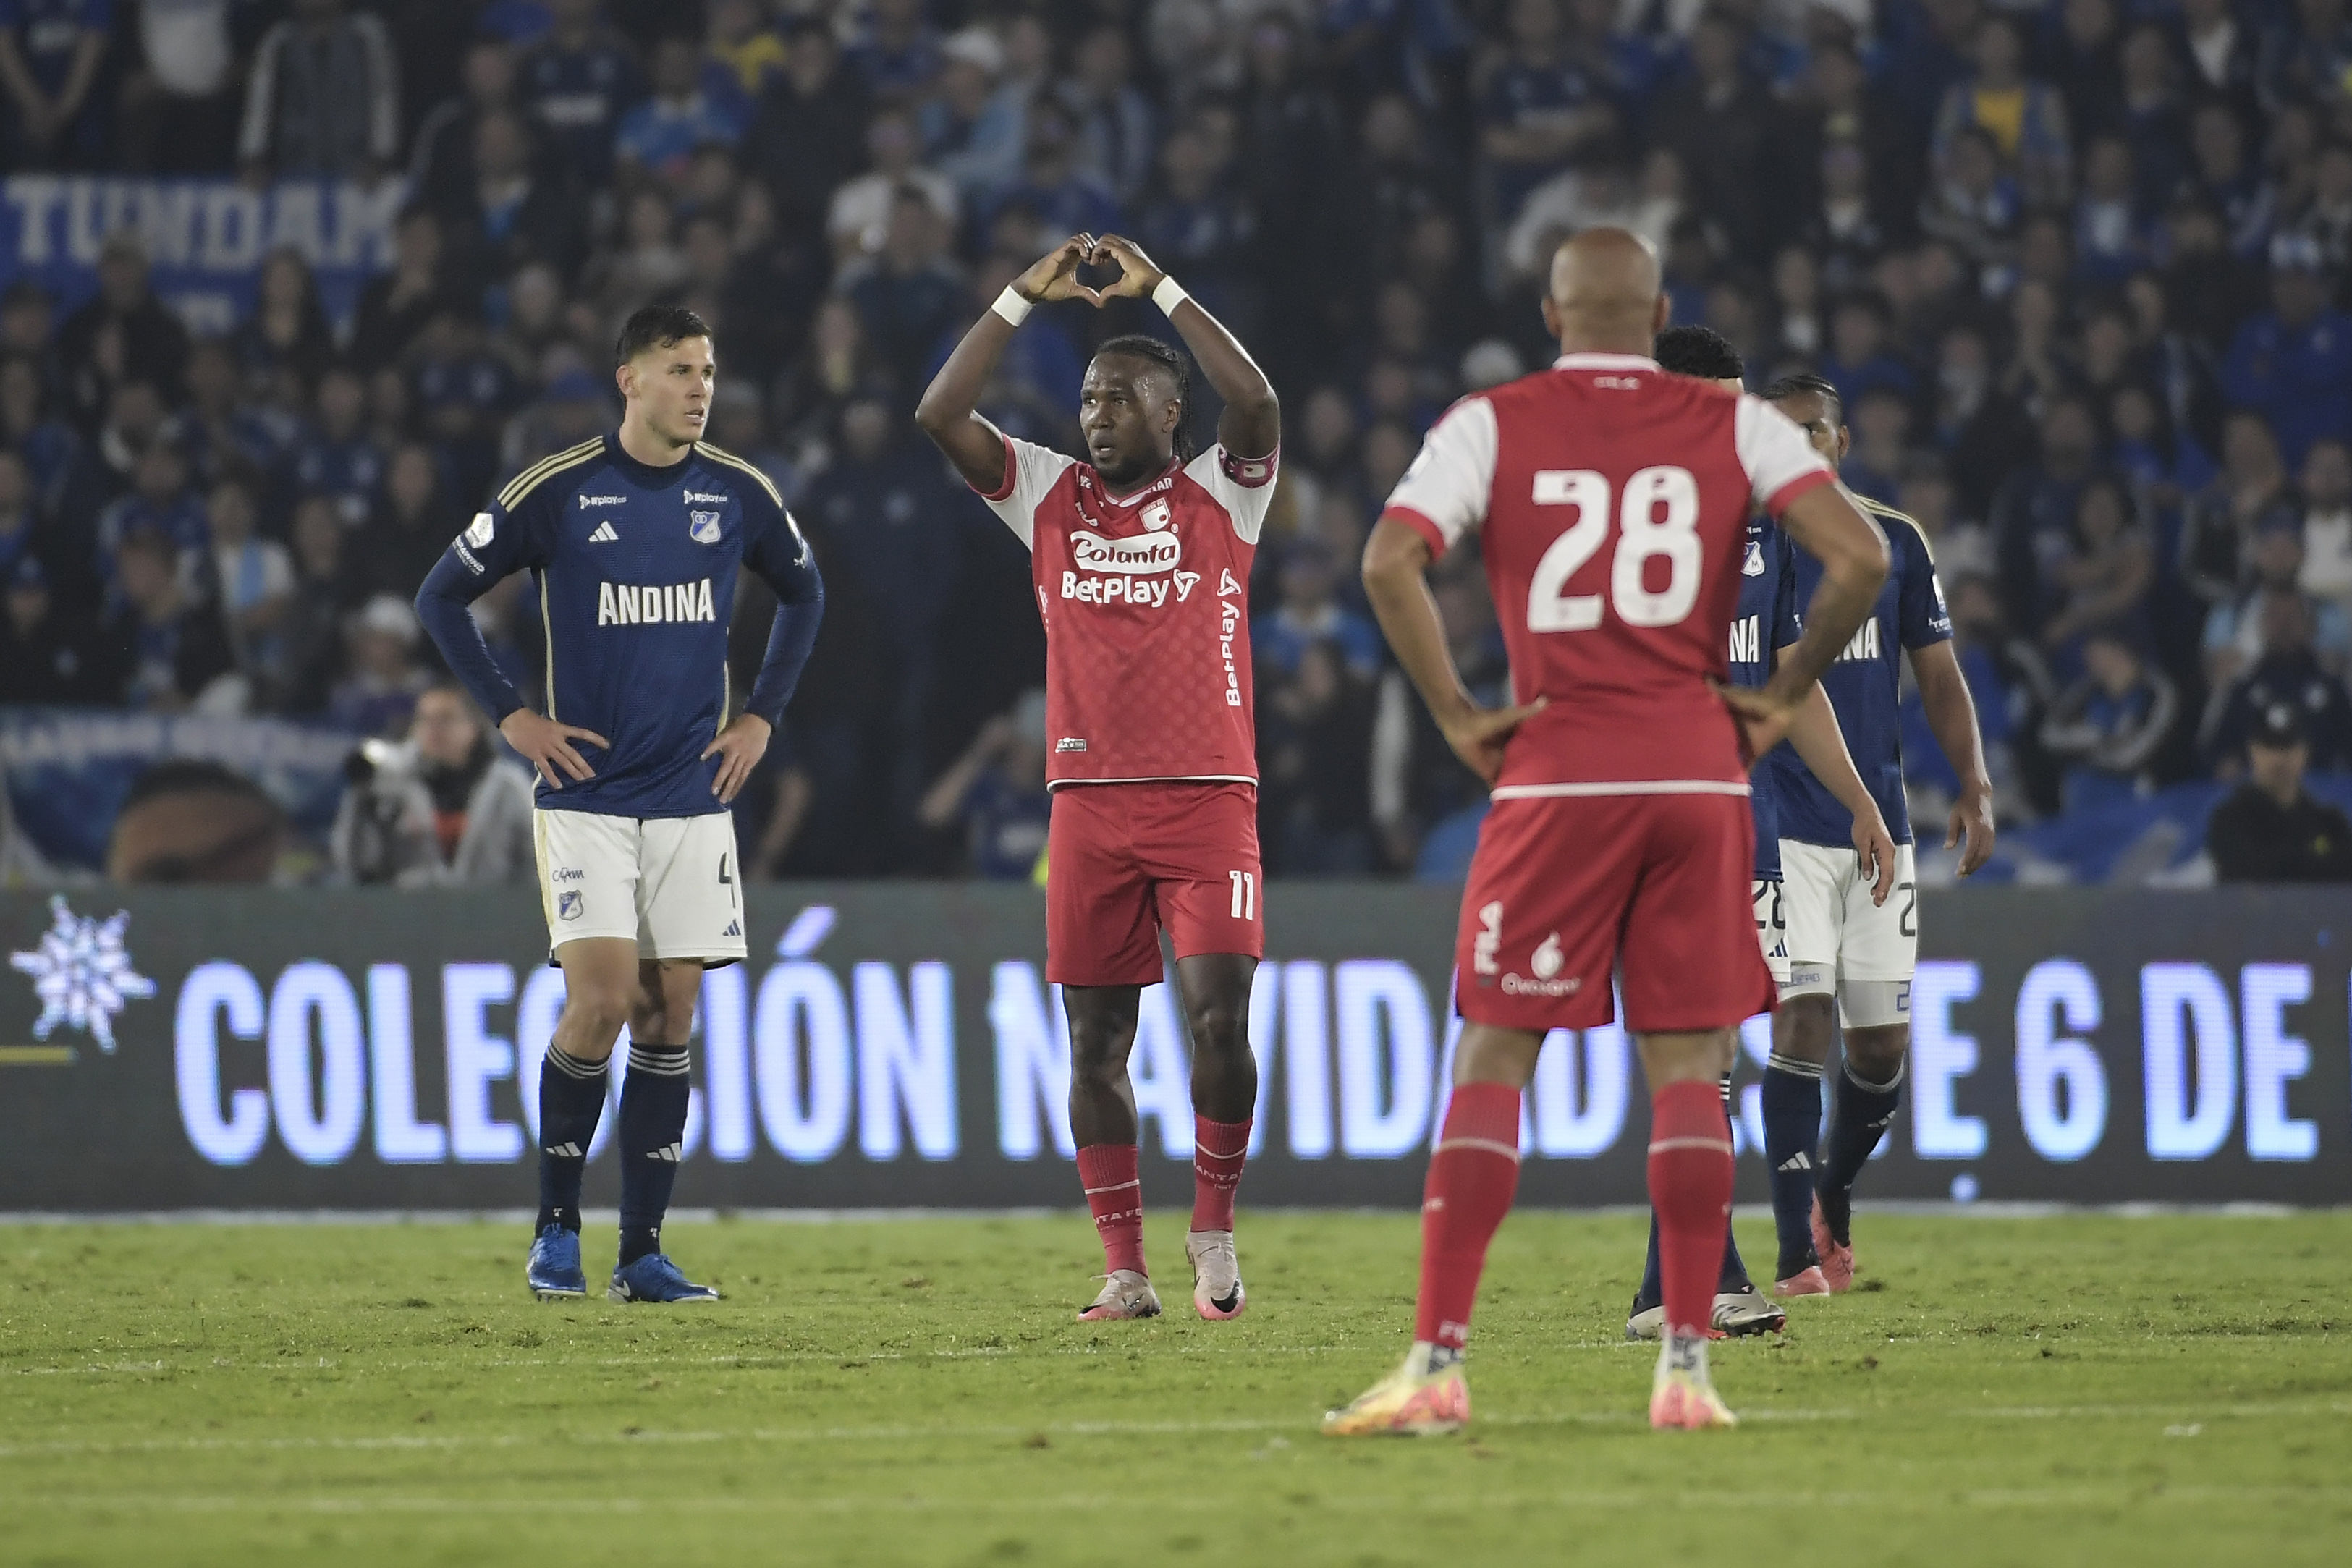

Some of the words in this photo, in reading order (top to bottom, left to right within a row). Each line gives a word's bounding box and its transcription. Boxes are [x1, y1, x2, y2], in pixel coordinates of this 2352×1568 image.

[1072, 538, 1177, 565] Colanta
[1527, 464, 1704, 634] 28
[598, 577, 716, 627] ANDINA
[1061, 571, 1169, 608] BetPlay
[1219, 600, 1242, 707] BetPlay
[718, 852, 737, 910] 4
[1228, 870, 1254, 921] 11
[174, 906, 960, 1165] COLECIÓN
[991, 960, 1630, 1161] NAIDD
[2014, 957, 2107, 1163] 6
[2140, 959, 2321, 1162] DE
